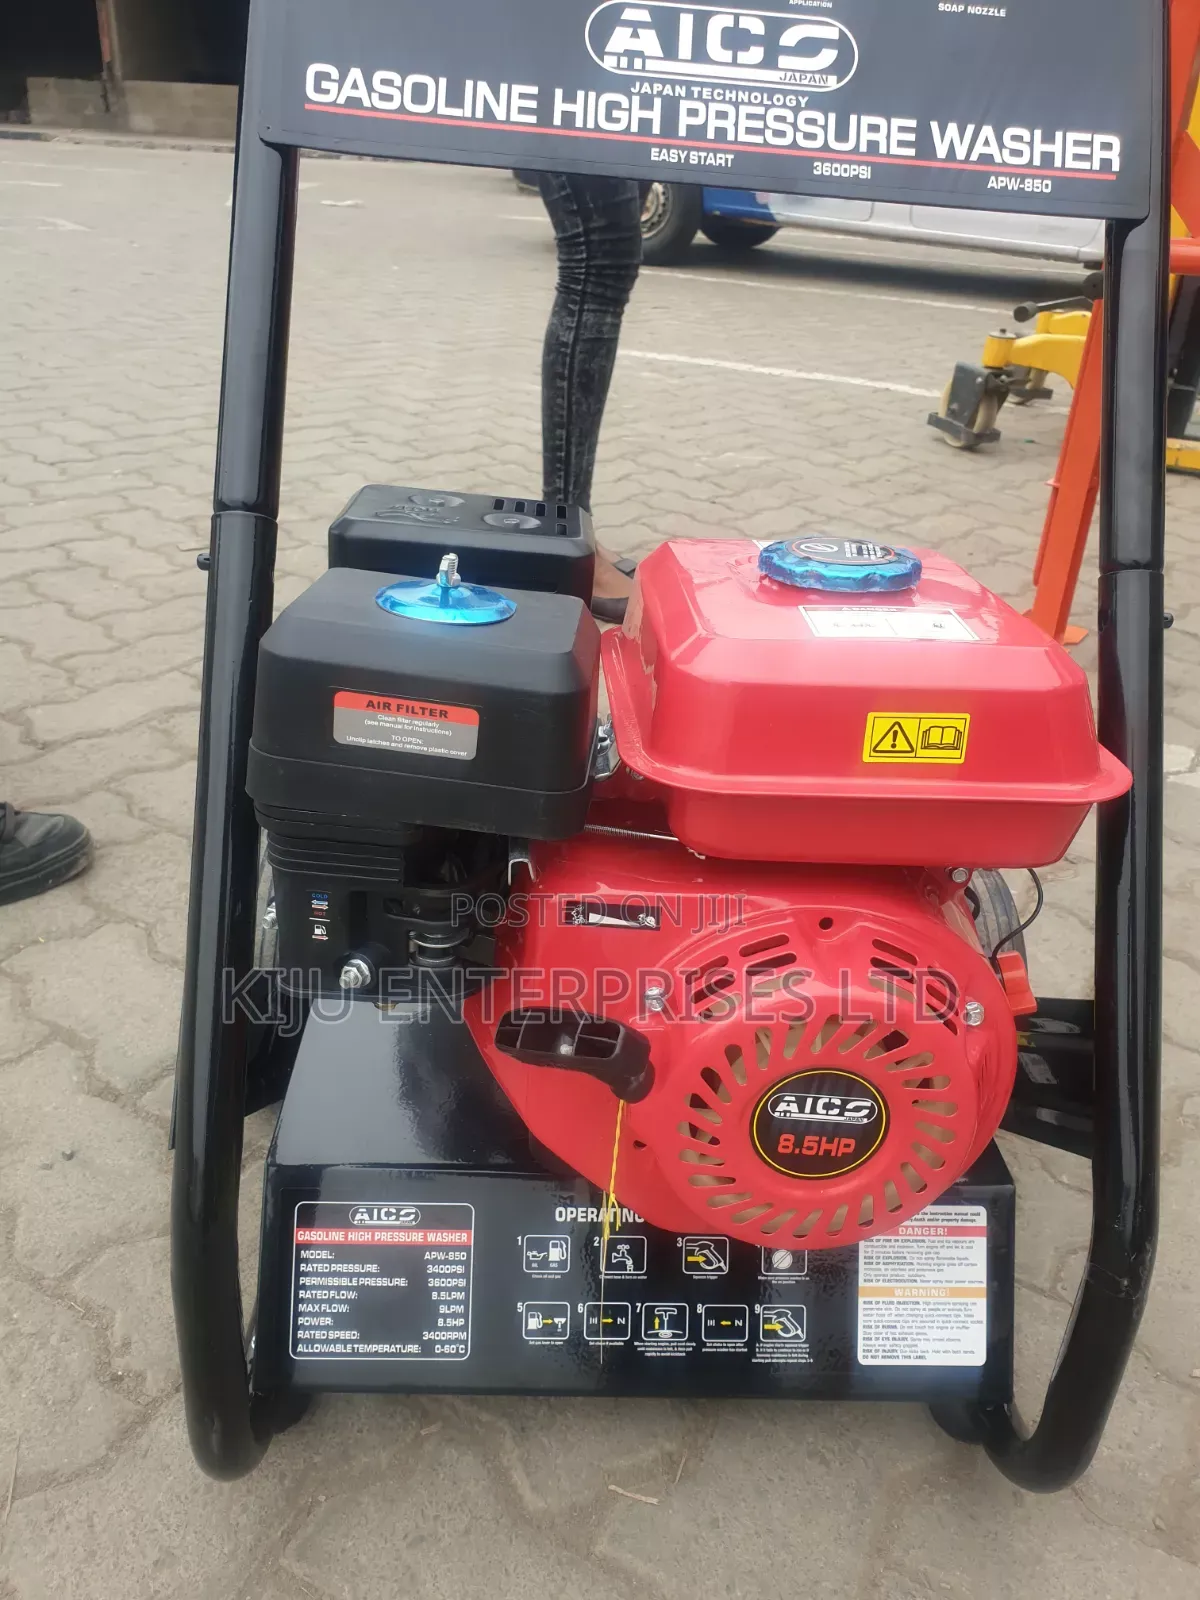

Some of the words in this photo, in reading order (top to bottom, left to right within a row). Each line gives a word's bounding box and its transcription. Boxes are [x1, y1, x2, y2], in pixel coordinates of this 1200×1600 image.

[938, 3, 965, 13] SOAP
[967, 6, 1006, 17] NOZZLE
[604, 8, 840, 71] AICS
[779, 72, 829, 86] JAPAN
[630, 81, 694, 98] JAPAN
[698, 86, 809, 107] TECHNOLOGY
[304, 63, 538, 124] GASOLINE
[553, 86, 661, 135] HIGH
[678, 103, 917, 156] PRESSURE
[929, 120, 1121, 172] WASHER
[650, 148, 686, 163] EASY
[689, 151, 734, 168] START
[813, 162, 872, 179] 3600PSI
[987, 175, 1052, 194] APW-850
[366, 700, 392, 711] AIR
[396, 703, 449, 719] FILTER
[377, 714, 397, 722] Clean
[397, 716, 411, 724] filter
[412, 719, 440, 729] regularly
[379, 721, 403, 730] manual
[413, 725, 452, 736] instructions)
[402, 737, 424, 745] OPEN:
[367, 739, 390, 747] latches
[404, 744, 428, 752] remove
[428, 746, 449, 755] plastic
[774, 1095, 872, 1117] AICS
[777, 1133, 856, 1157] 8.5HP
[354, 1207, 416, 1221] AICS
[297, 1230, 345, 1241] GASOLINE
[348, 1231, 372, 1241] HIGH
[374, 1232, 424, 1242] PRESSURE
[427, 1232, 468, 1243] WASHER
[898, 1227, 948, 1236] DANGER!
[517, 1235, 522, 1246] 1
[593, 1236, 600, 1247] 2
[676, 1237, 683, 1248] 3
[300, 1250, 335, 1259] MODEL:
[424, 1251, 467, 1260] APW-850
[299, 1264, 330, 1272] RATED
[331, 1264, 380, 1273] PRESSURE:
[426, 1265, 465, 1273] 3400PSI
[299, 1277, 357, 1286] PERMISSIBLE
[358, 1278, 408, 1286] PRESSURE:
[427, 1278, 466, 1287] 3600PSI
[299, 1290, 329, 1299] RATED
[329, 1291, 358, 1299] FLOW:
[431, 1291, 465, 1300] 8.5LPM
[894, 1288, 949, 1297] WARNING!
[298, 1304, 320, 1312] MAX
[320, 1304, 350, 1312] FLOW:
[439, 1305, 464, 1313] 9LPM
[517, 1302, 523, 1313] 5
[577, 1303, 584, 1313] 6
[636, 1303, 642, 1313] 7
[696, 1304, 702, 1313] 8
[754, 1304, 761, 1314] 9
[298, 1318, 334, 1326] POWER:
[437, 1318, 465, 1327] 8.5HP
[297, 1331, 327, 1339] RATED
[328, 1331, 360, 1340] SPEED:
[297, 1344, 352, 1353] ALLOWABLE
[353, 1344, 421, 1353] TEMPERATURE:
